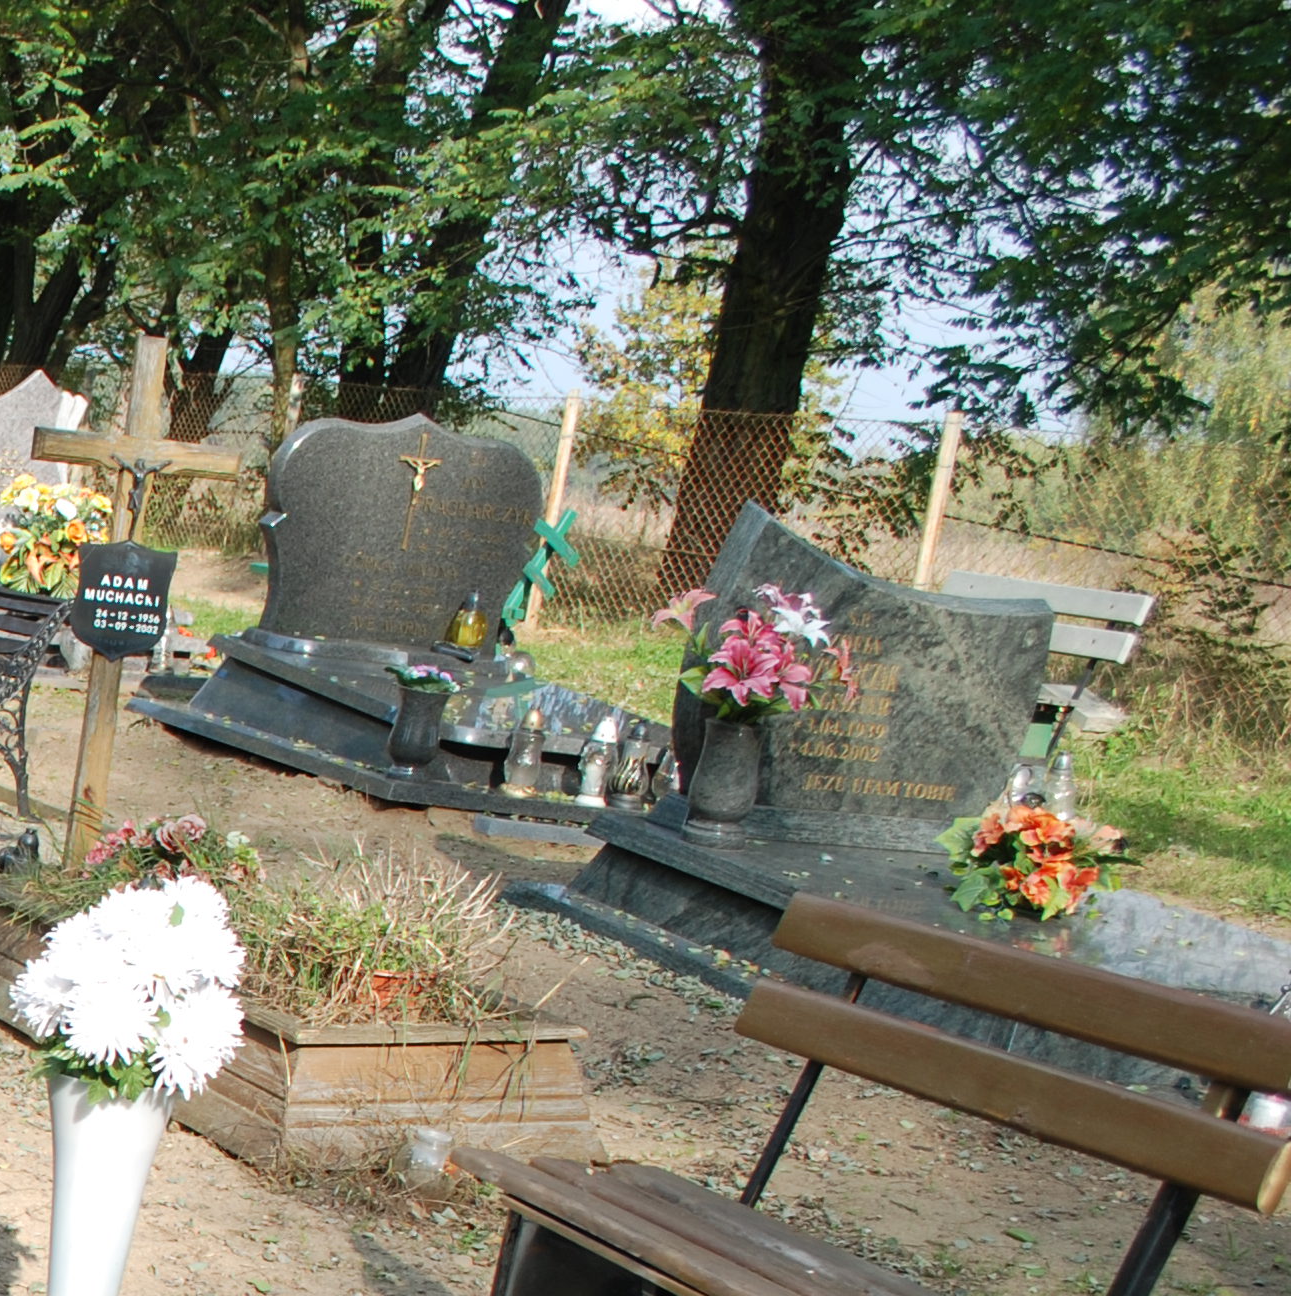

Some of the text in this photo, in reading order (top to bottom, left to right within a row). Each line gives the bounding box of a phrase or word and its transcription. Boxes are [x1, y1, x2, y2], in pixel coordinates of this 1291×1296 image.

[100, 573, 149, 591] ADAM
[84, 587, 160, 608] MUCHACKI
[801, 774, 958, 802] JEZU UFAM TOBIE
